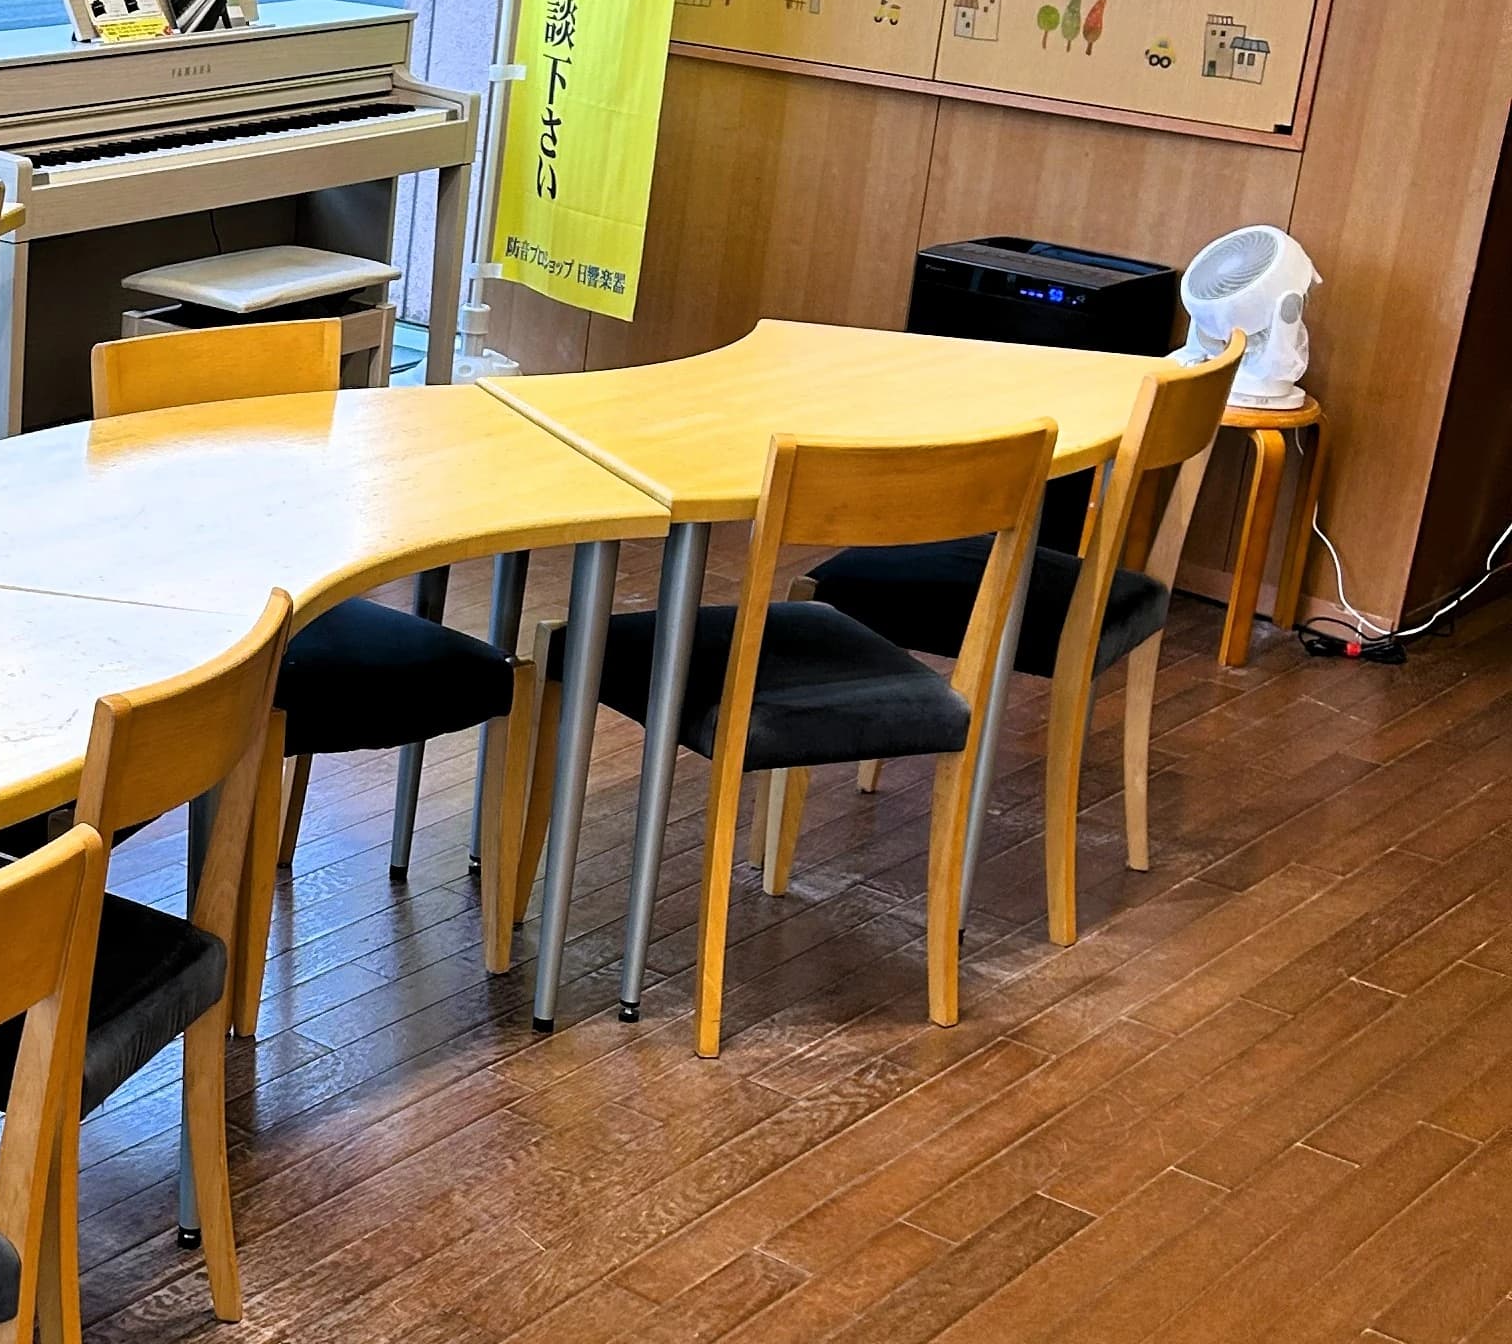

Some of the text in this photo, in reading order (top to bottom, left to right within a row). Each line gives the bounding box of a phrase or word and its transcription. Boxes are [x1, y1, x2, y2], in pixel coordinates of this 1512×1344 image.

[505, 236, 575, 278] 防音プロショップ
